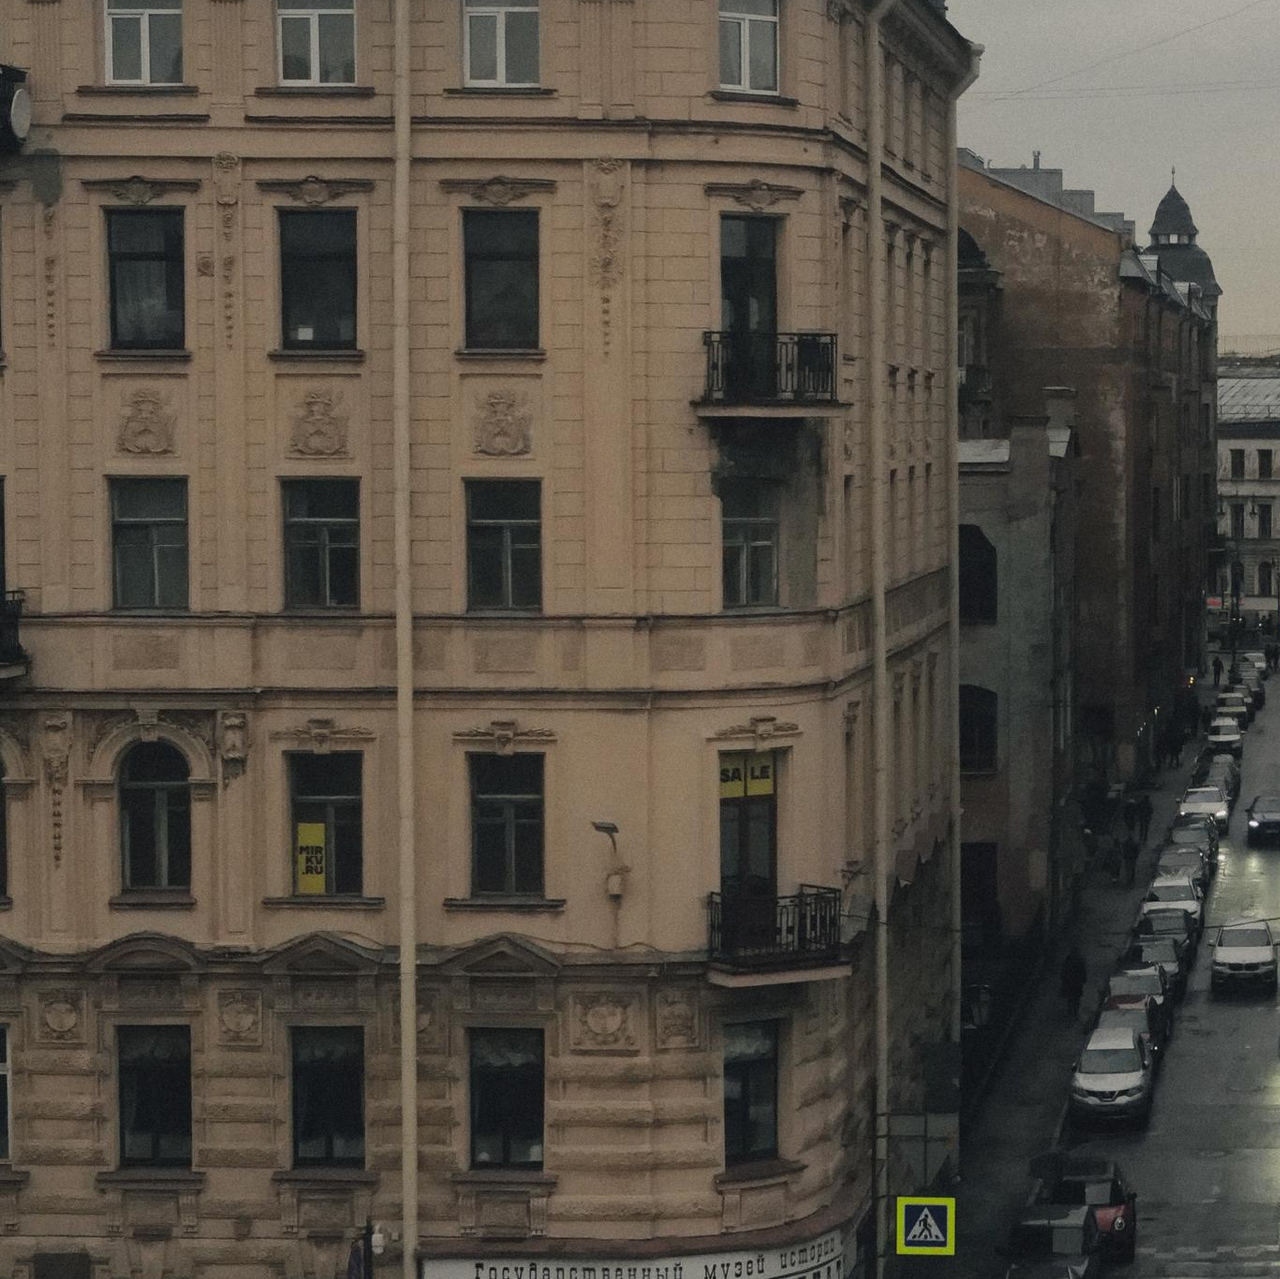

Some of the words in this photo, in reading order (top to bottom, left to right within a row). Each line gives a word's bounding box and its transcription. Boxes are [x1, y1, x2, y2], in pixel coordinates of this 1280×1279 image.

[720, 765, 771, 783] SALE
[299, 846, 323, 855] MIR
[305, 855, 324, 865] KV
[302, 865, 324, 875] .RU
[780, 1236, 835, 1264] истории
